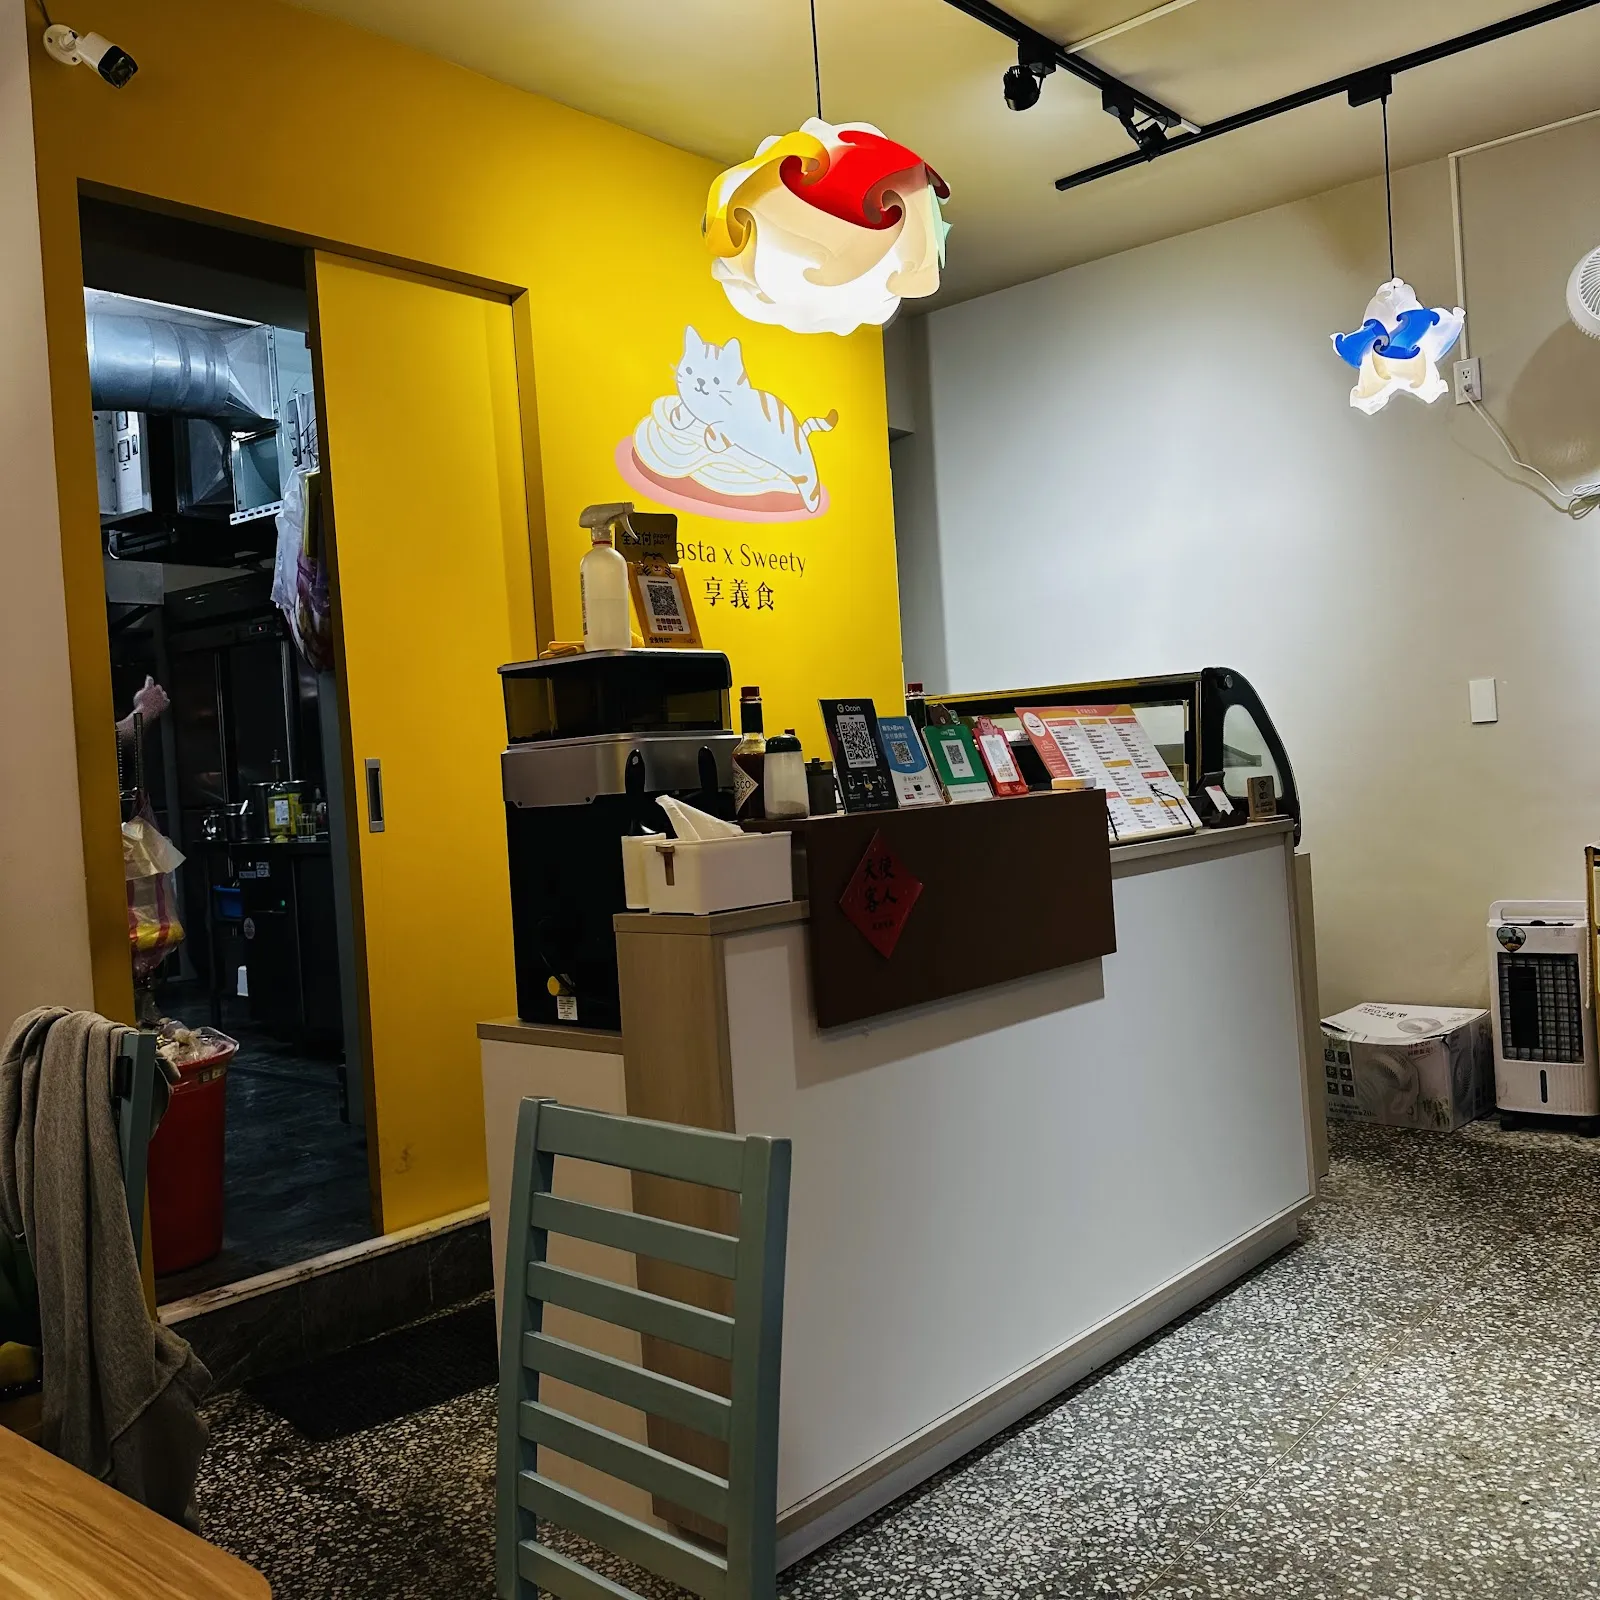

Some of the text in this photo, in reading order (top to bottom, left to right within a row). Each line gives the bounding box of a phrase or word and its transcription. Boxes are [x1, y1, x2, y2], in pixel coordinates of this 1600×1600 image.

[676, 540, 806, 578] asta x Sweety
[703, 576, 774, 611] 享義食
